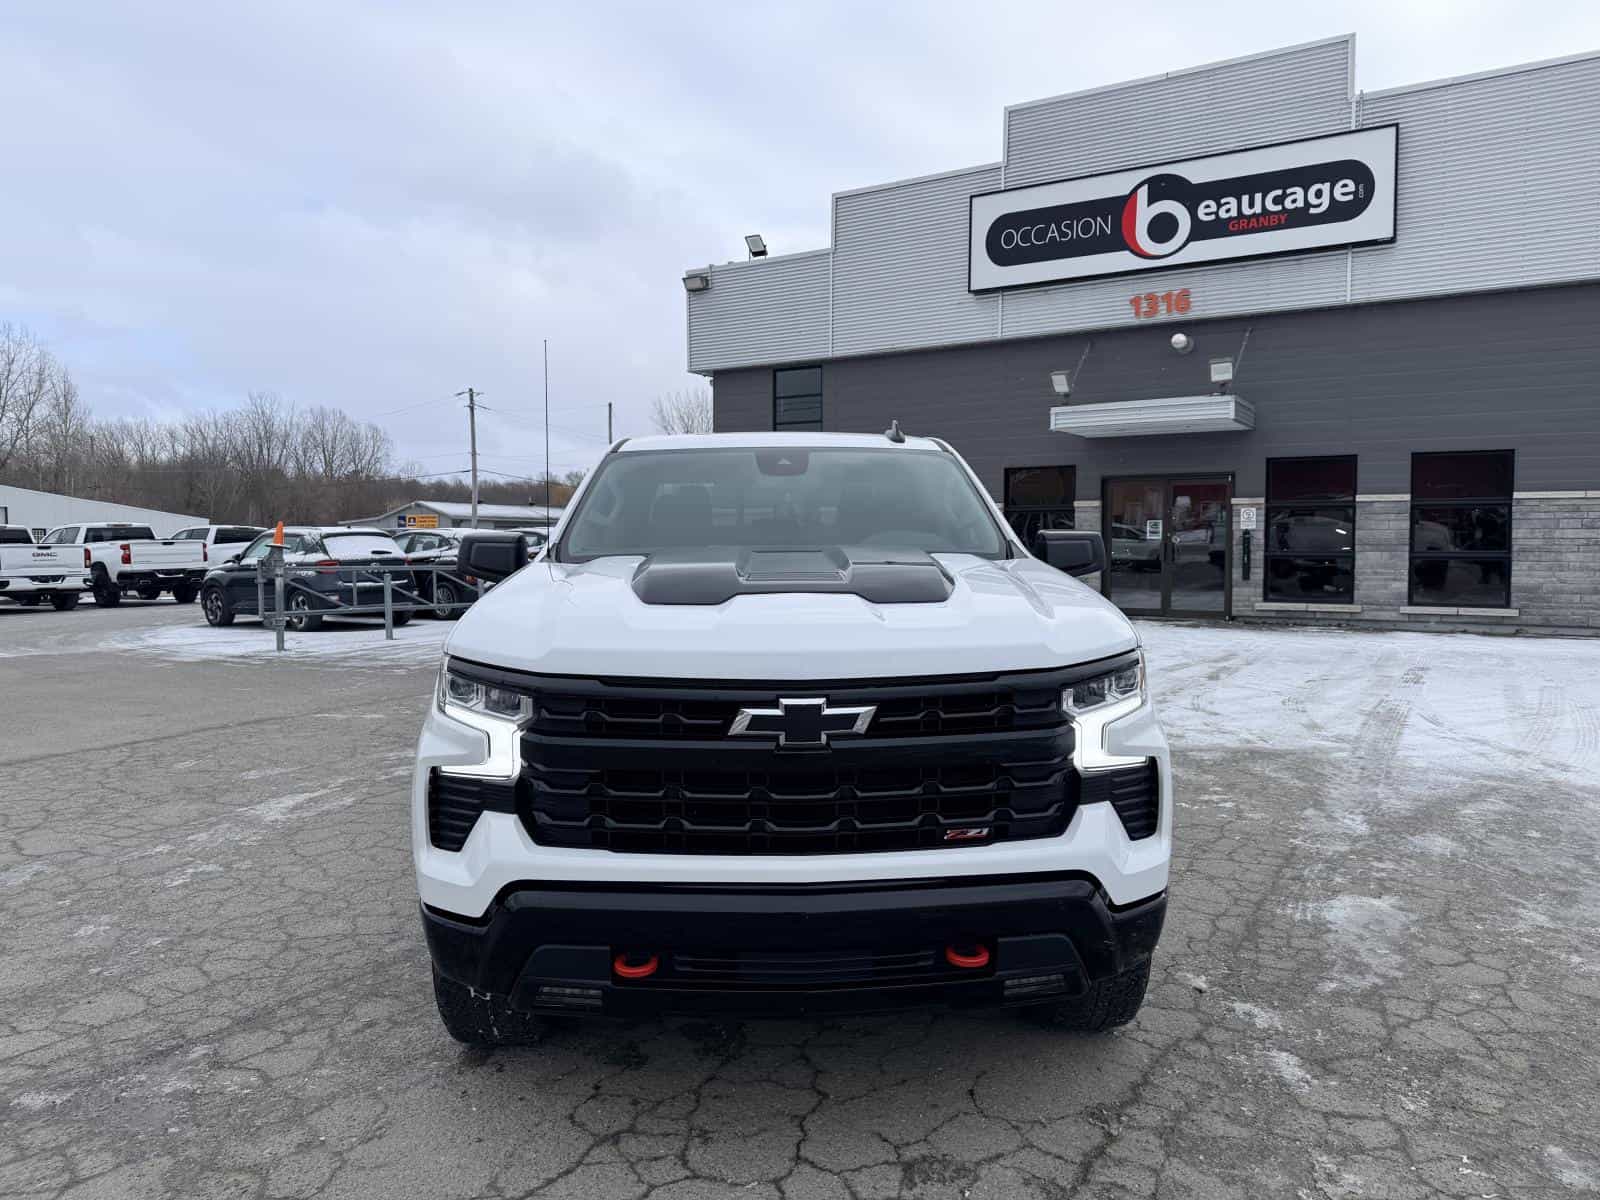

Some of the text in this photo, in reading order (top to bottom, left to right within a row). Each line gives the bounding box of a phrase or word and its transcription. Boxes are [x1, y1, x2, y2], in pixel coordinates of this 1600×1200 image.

[1001, 178, 1356, 257] OCCASION beaucage
[1228, 213, 1288, 231] GRANBY
[1129, 288, 1192, 319] 1316
[944, 827, 990, 840] Z71
